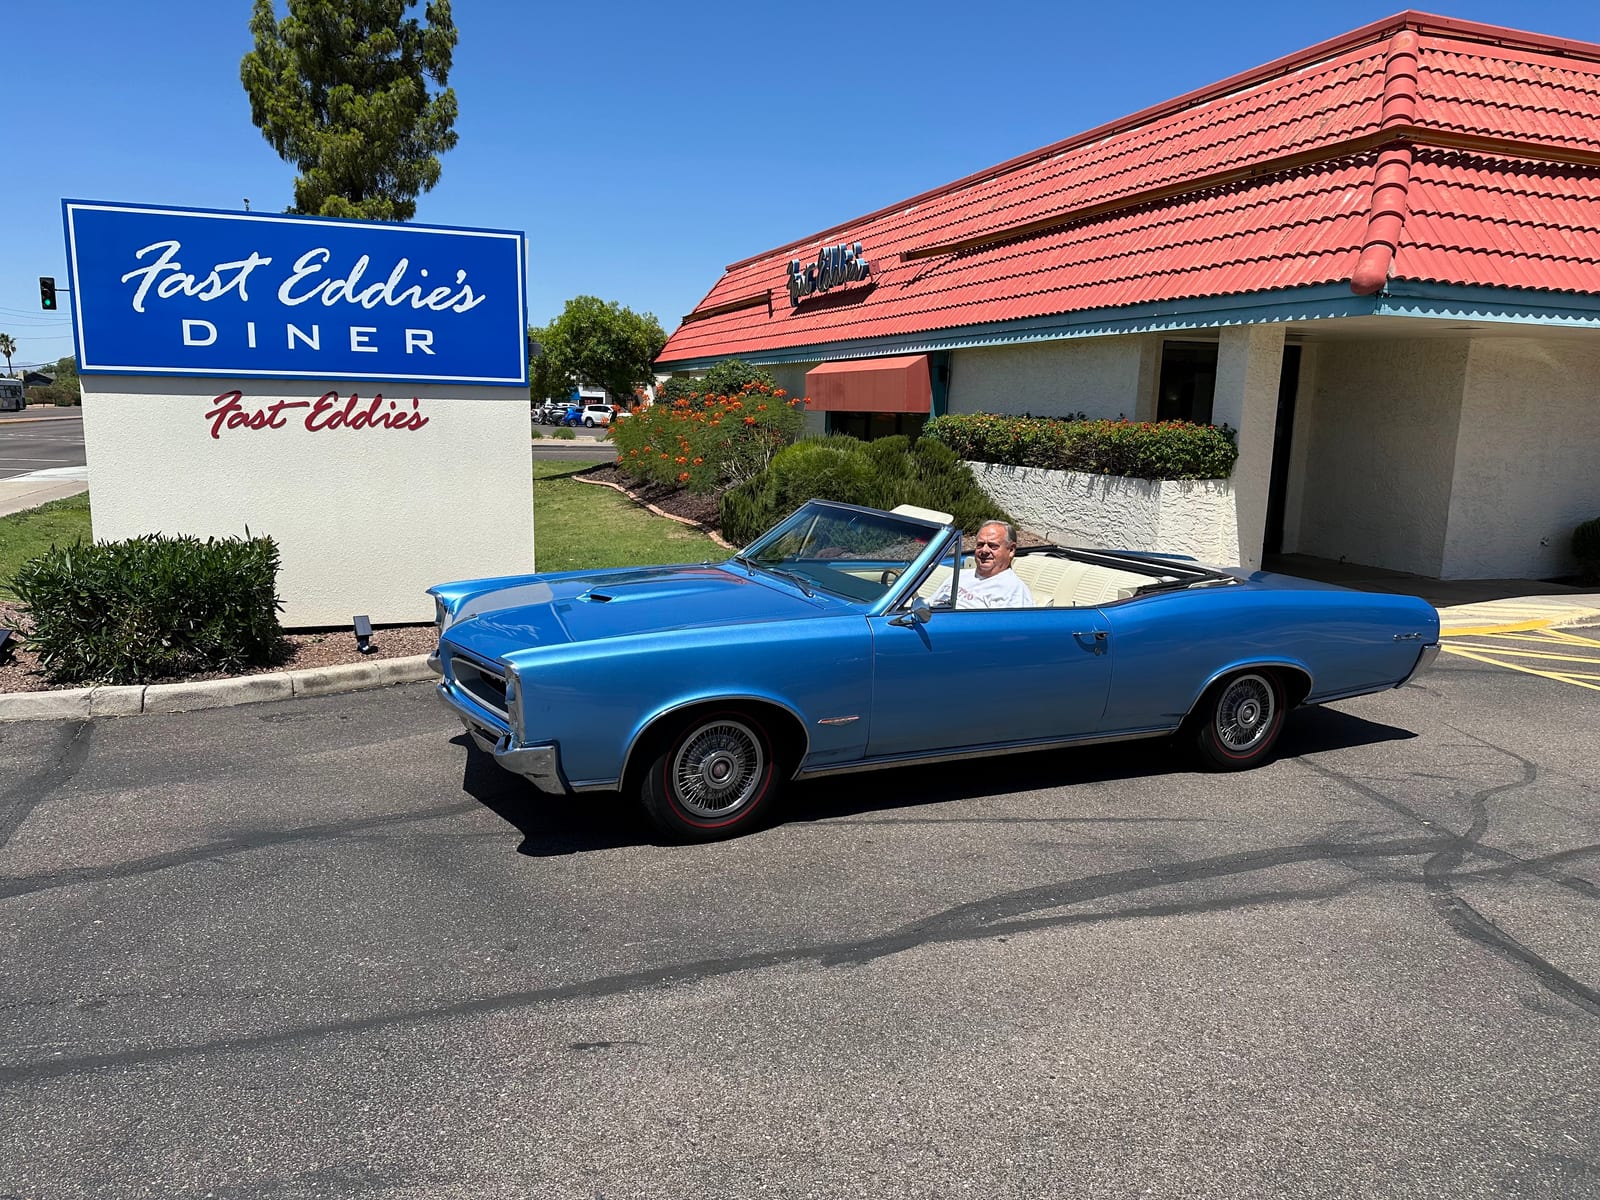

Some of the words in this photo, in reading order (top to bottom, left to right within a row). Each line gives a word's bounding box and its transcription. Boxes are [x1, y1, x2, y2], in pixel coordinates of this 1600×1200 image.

[121, 240, 273, 313] Fast
[277, 247, 486, 314] Eddie's
[182, 319, 437, 356] DINER
[205, 390, 310, 439] Fast
[304, 391, 429, 432] Eddie's
